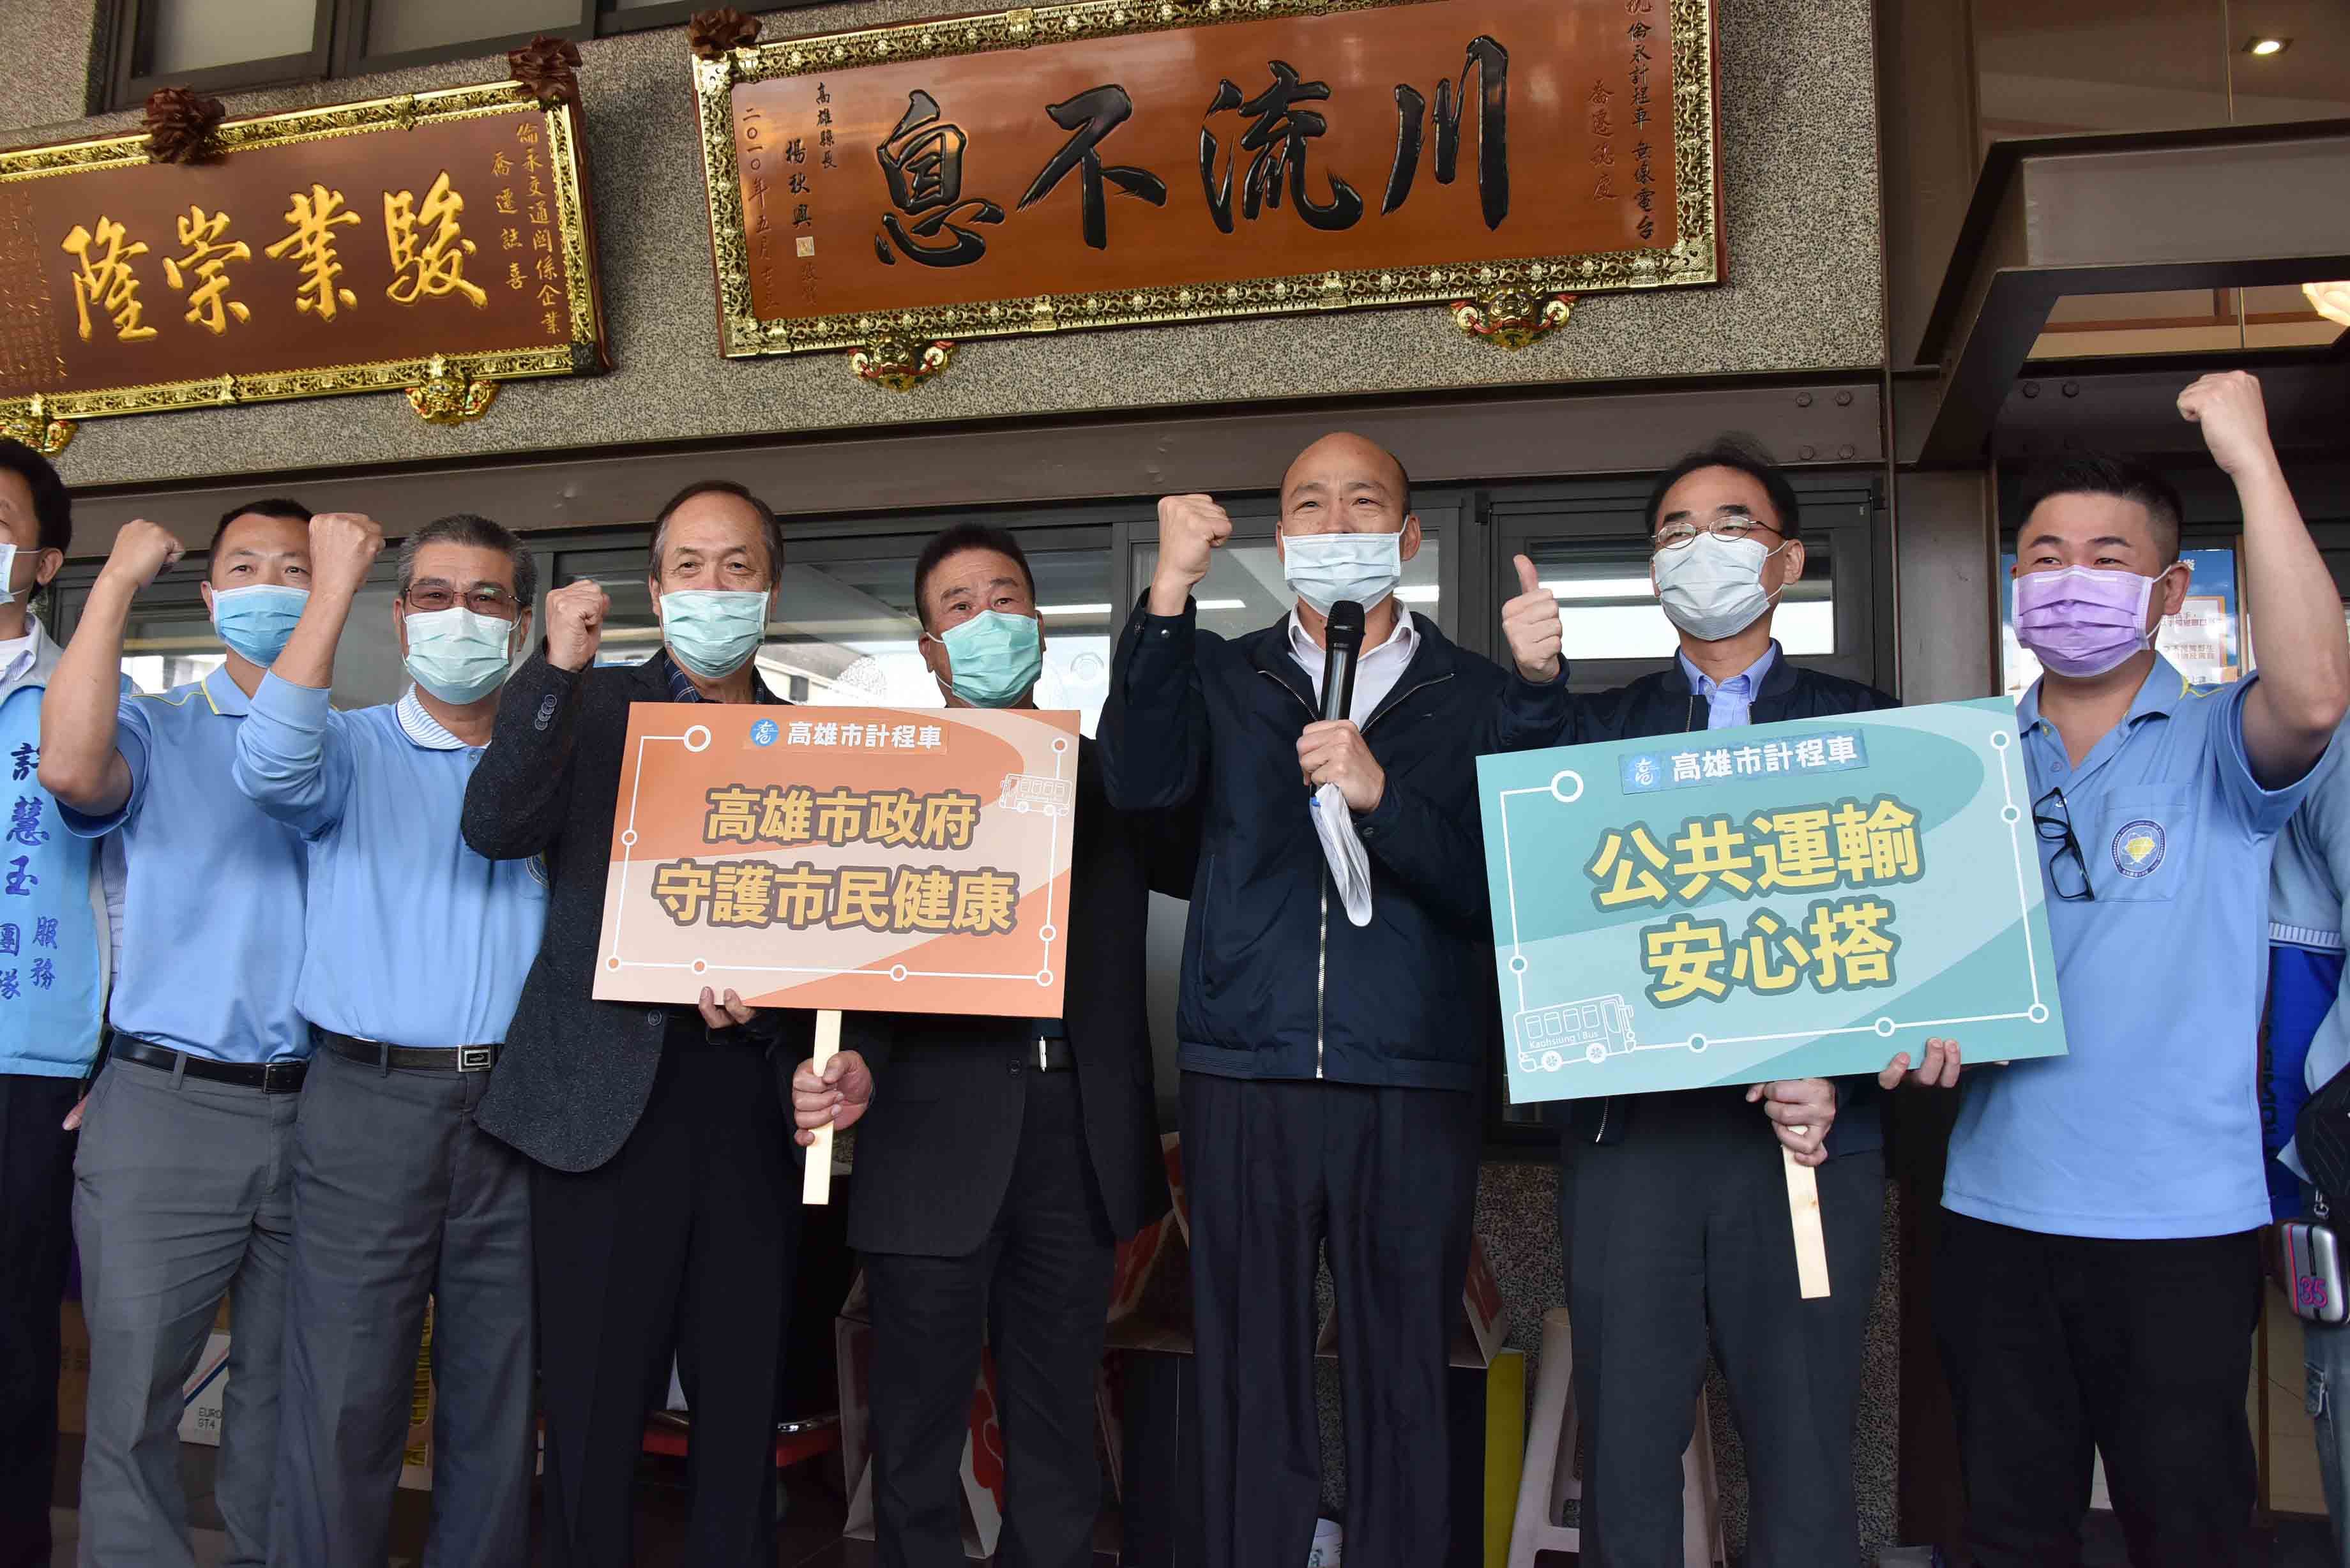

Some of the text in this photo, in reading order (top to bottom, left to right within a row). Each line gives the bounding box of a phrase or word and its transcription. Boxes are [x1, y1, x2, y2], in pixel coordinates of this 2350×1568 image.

[786, 721, 942, 750] 高雄市計程車
[1671, 735, 1858, 783] 高雄市計程車
[704, 785, 979, 847] 高雄市政府
[1588, 796, 1922, 910] 公共運輸
[653, 860, 1017, 933] 守護市民健康
[31, 916, 59, 990] 服務
[1643, 899, 1895, 1005] 安心搭
